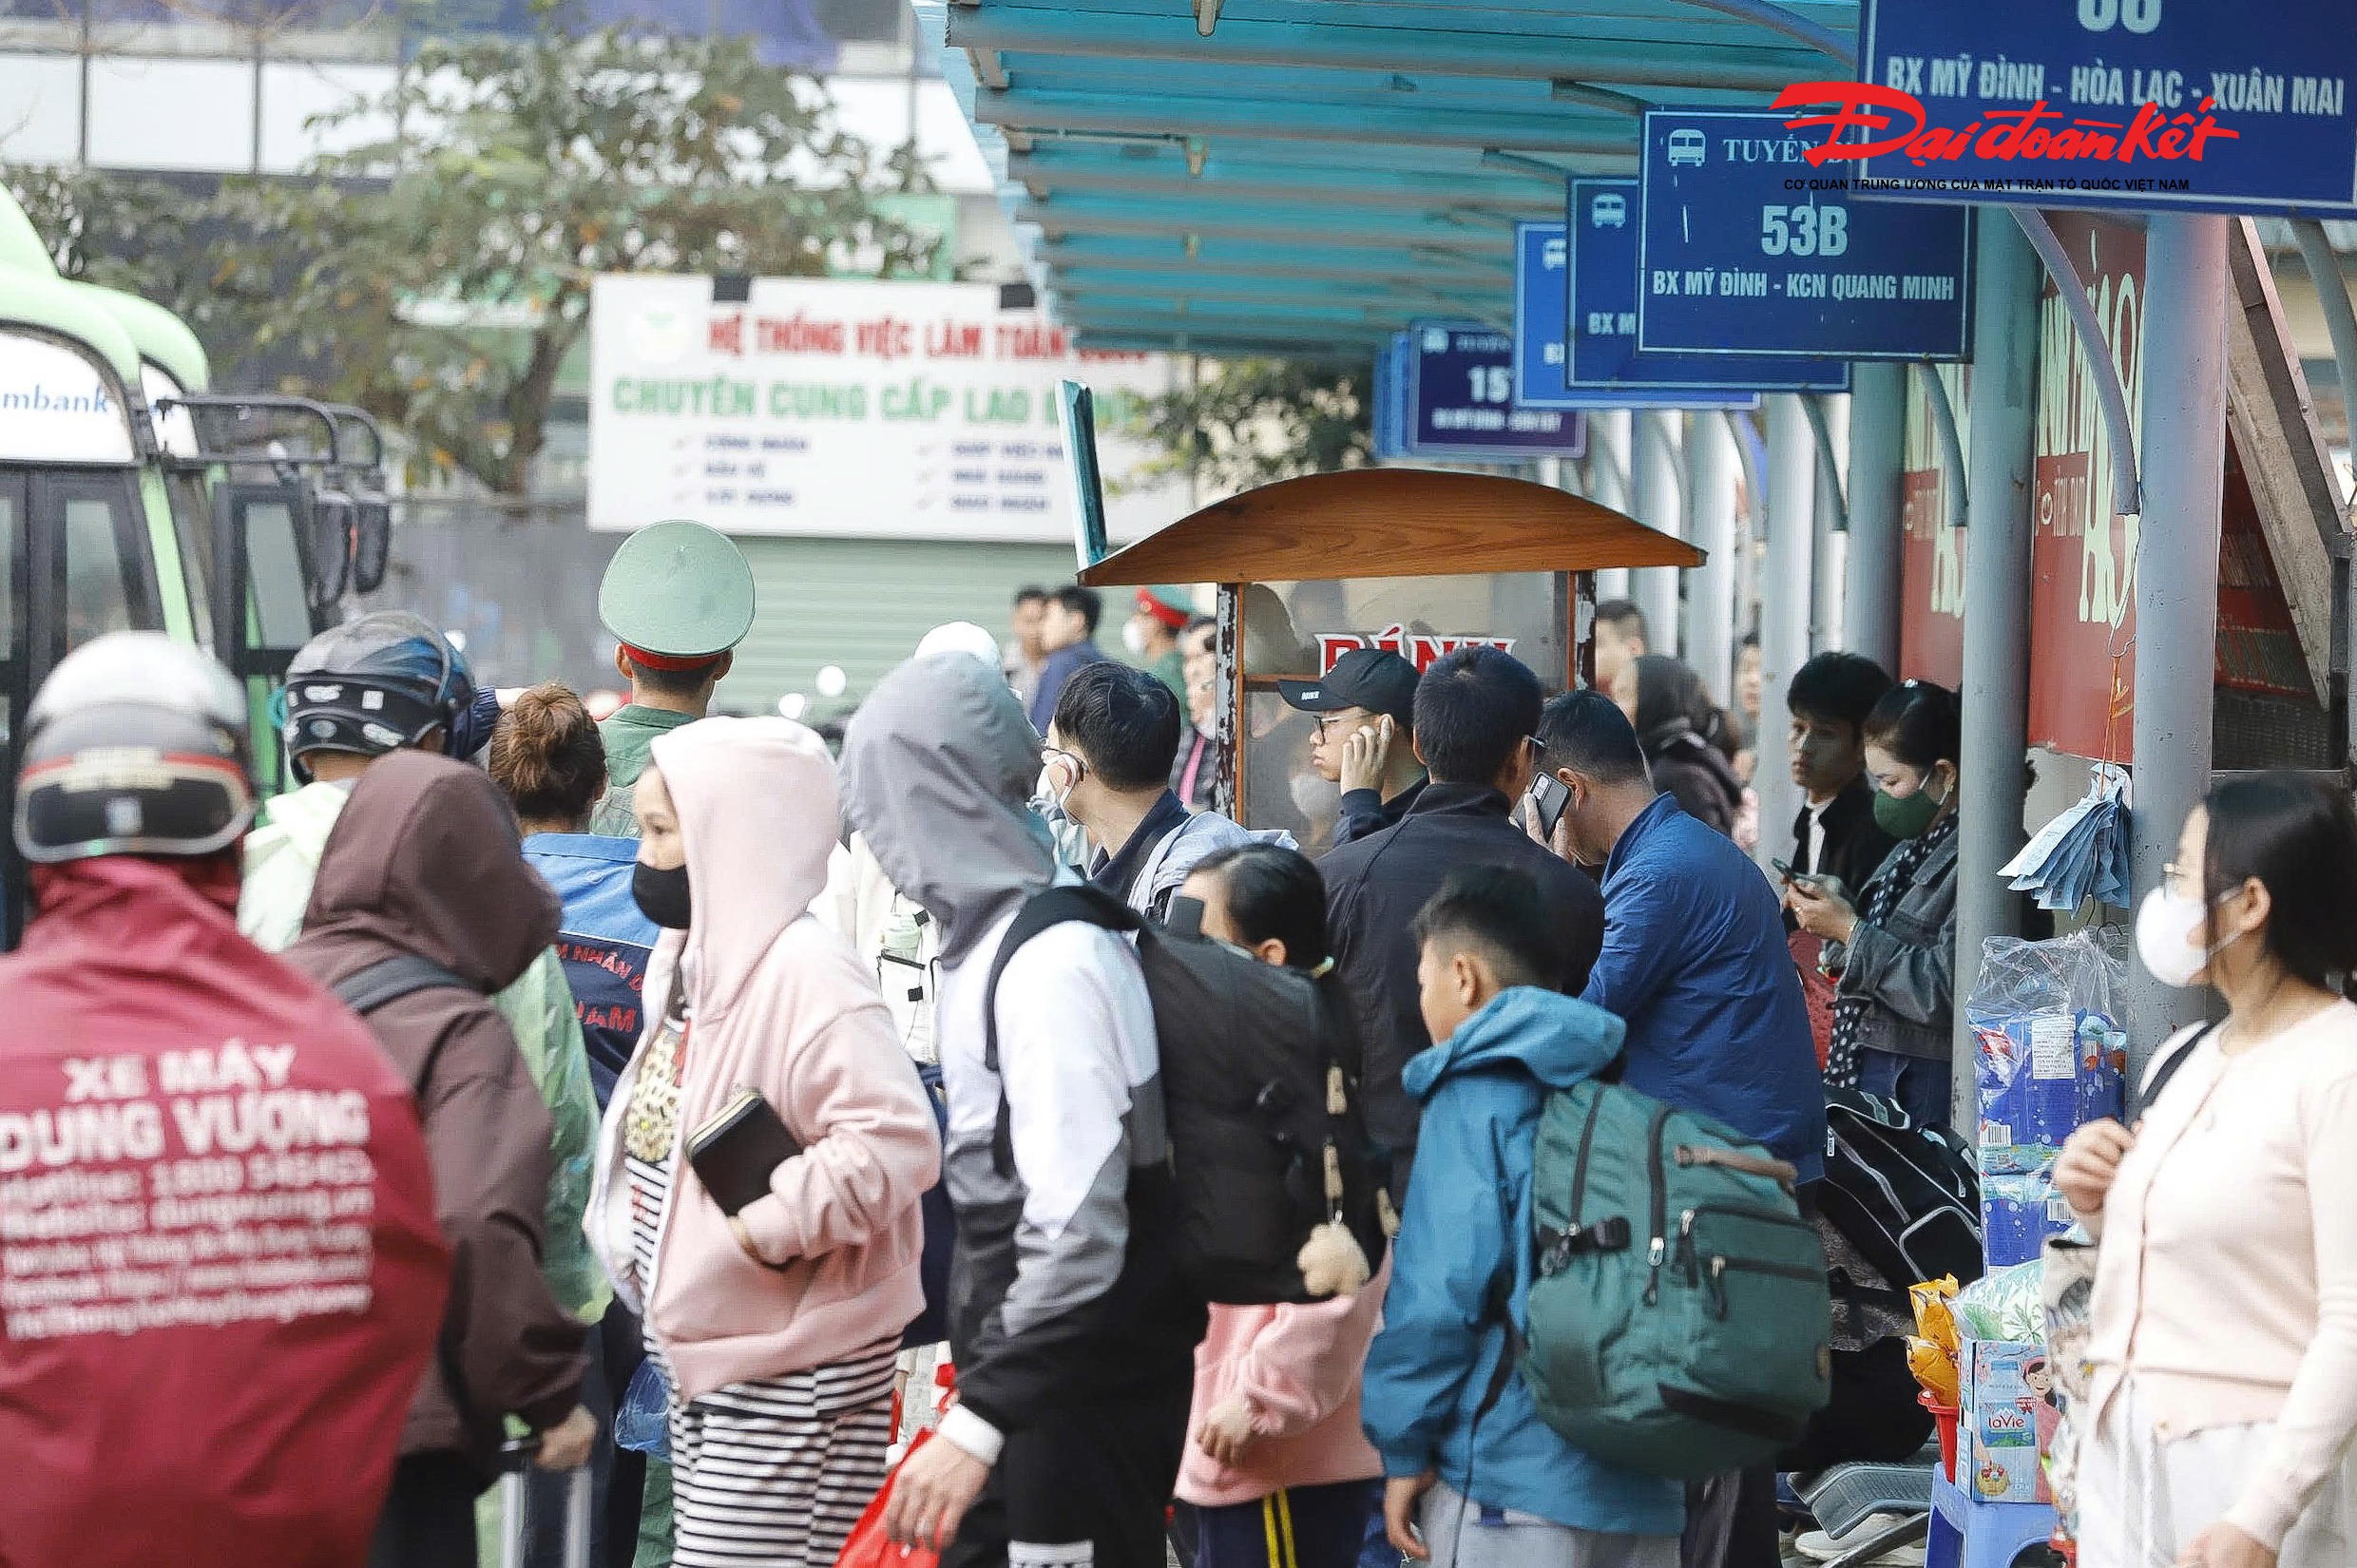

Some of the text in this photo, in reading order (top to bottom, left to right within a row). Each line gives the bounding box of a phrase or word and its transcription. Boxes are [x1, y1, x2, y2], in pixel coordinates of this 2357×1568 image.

[1887, 56, 1924, 95] BX
[1930, 53, 1972, 97] MỸ
[1980, 54, 2045, 100] ĐÌNH
[2071, 59, 2127, 105] HÒA
[2210, 67, 2285, 113] XUÂN
[2291, 77, 2345, 115] MAI
[1761, 205, 1849, 257] 53B
[1653, 271, 1679, 296] BX
[1684, 267, 1715, 296] MỸ
[1720, 268, 1768, 296] ĐÌNH
[1787, 274, 1826, 298] KCN
[1832, 274, 1897, 300] QUANG
[1902, 276, 1955, 300] MINH
[1588, 312, 1613, 335] BX
[767, 382, 867, 418] CUNG
[62, 1055, 148, 1100] XE
